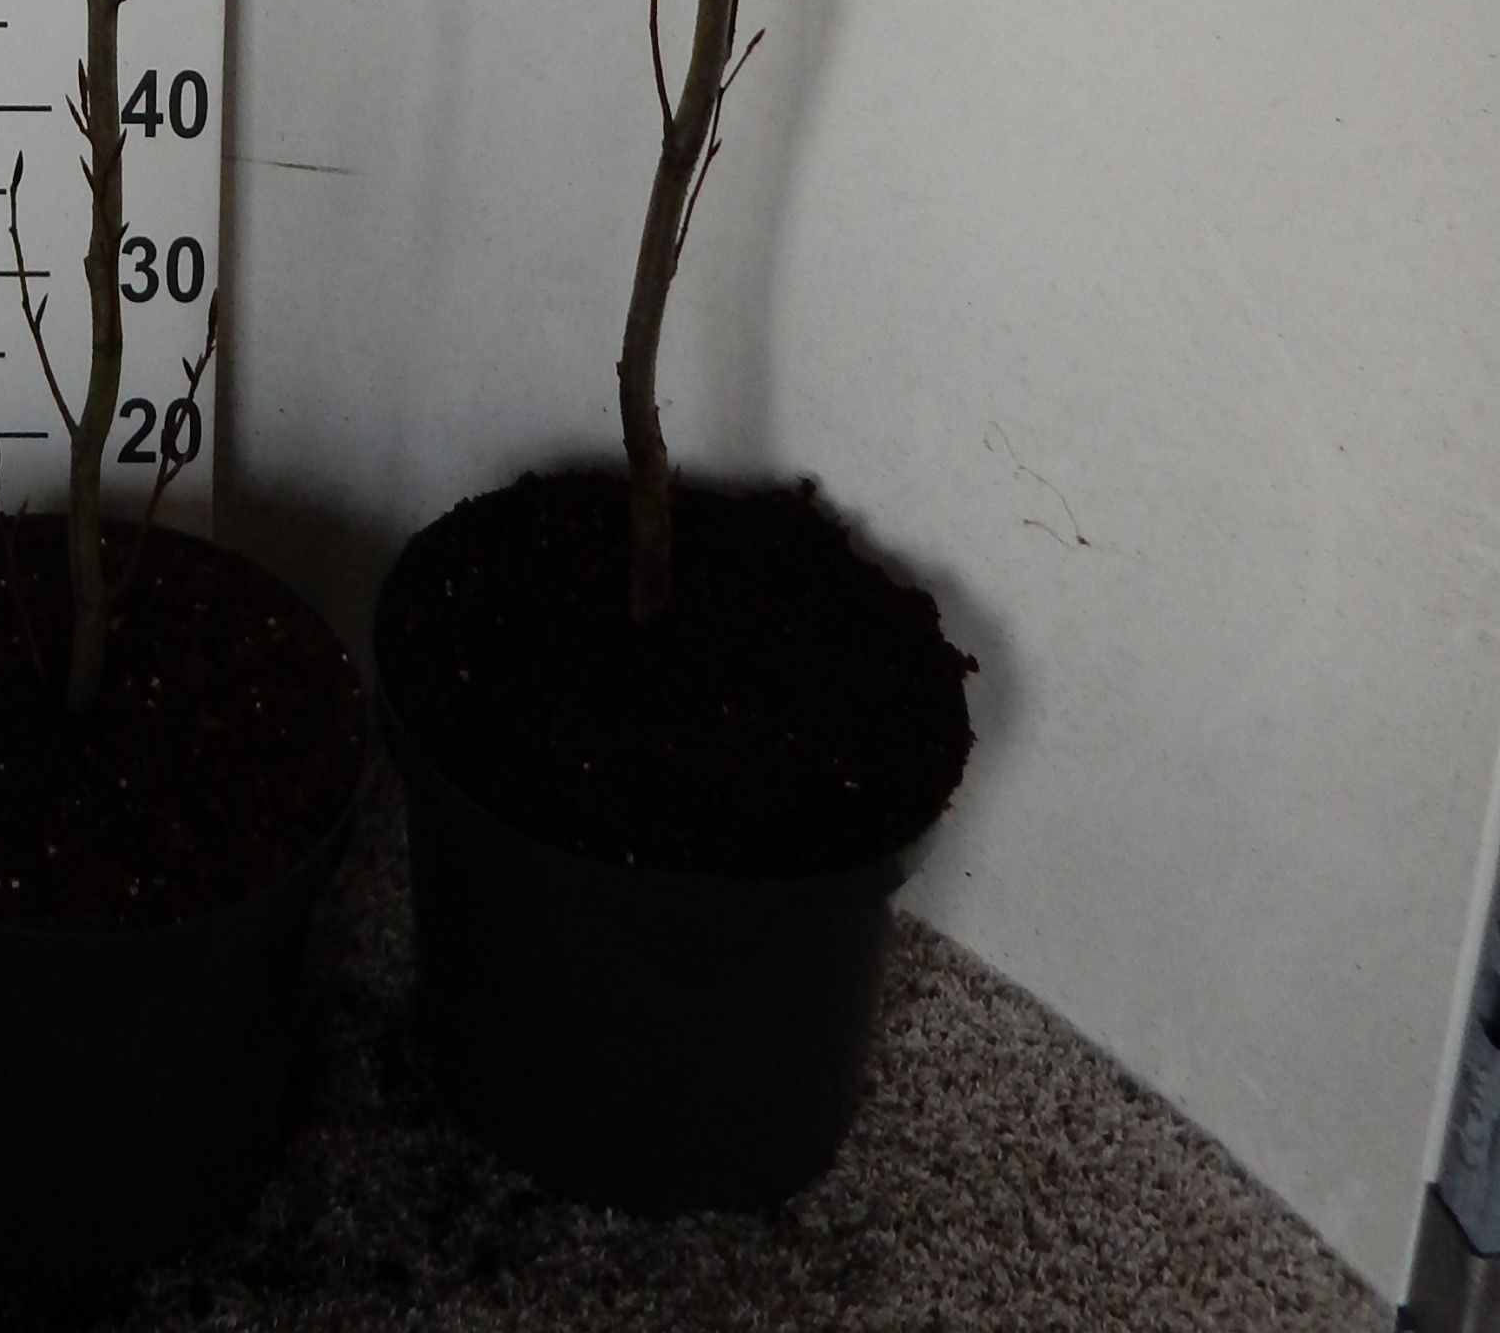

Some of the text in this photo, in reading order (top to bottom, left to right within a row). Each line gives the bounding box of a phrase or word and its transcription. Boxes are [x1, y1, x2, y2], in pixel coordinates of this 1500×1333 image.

[120, 69, 209, 139] 40
[119, 235, 205, 304] 30
[117, 397, 202, 464] 20
